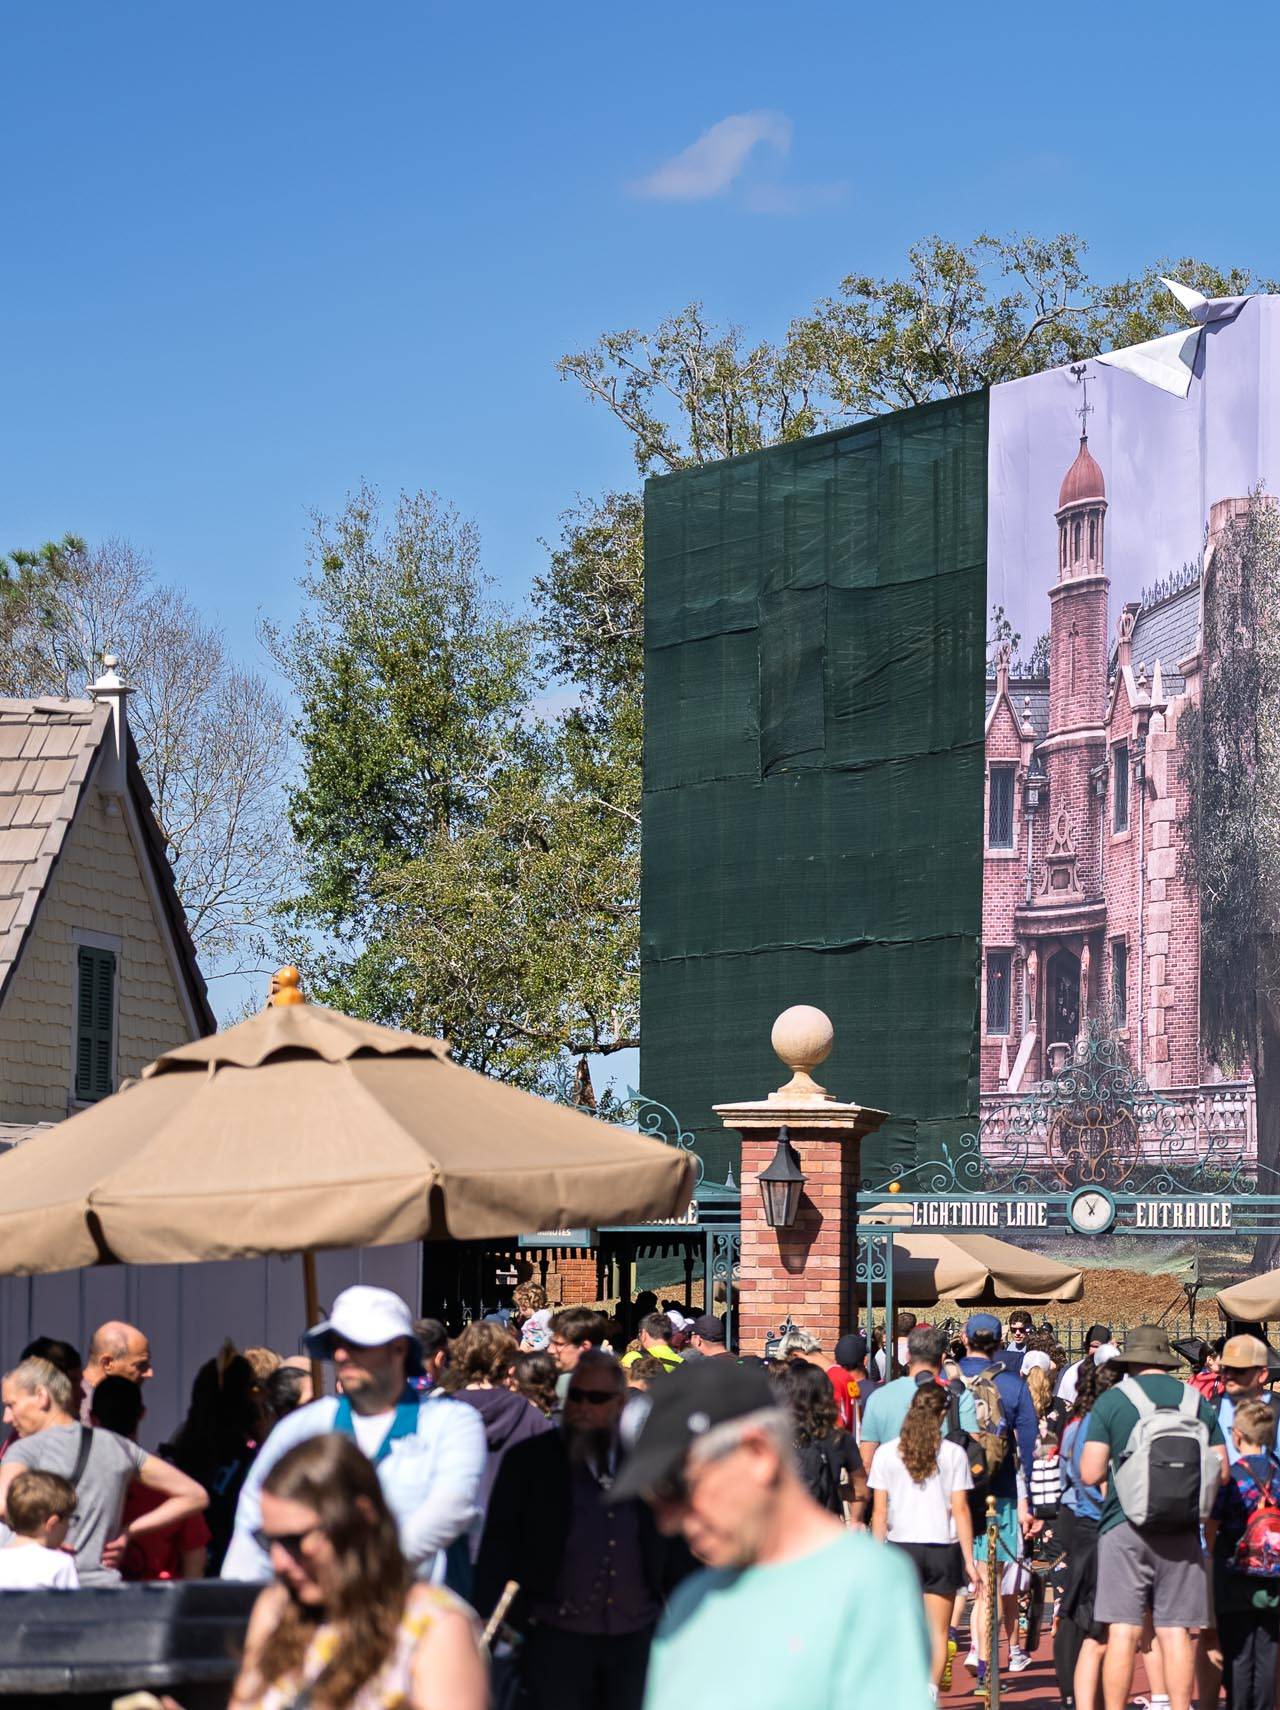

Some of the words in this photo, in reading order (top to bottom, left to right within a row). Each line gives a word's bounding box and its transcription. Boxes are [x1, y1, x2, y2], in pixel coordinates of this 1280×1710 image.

[912, 1202, 999, 1226] LIGHTNING
[1006, 1202, 1048, 1226] LANE
[1135, 1202, 1232, 1228] ENTRANCE
